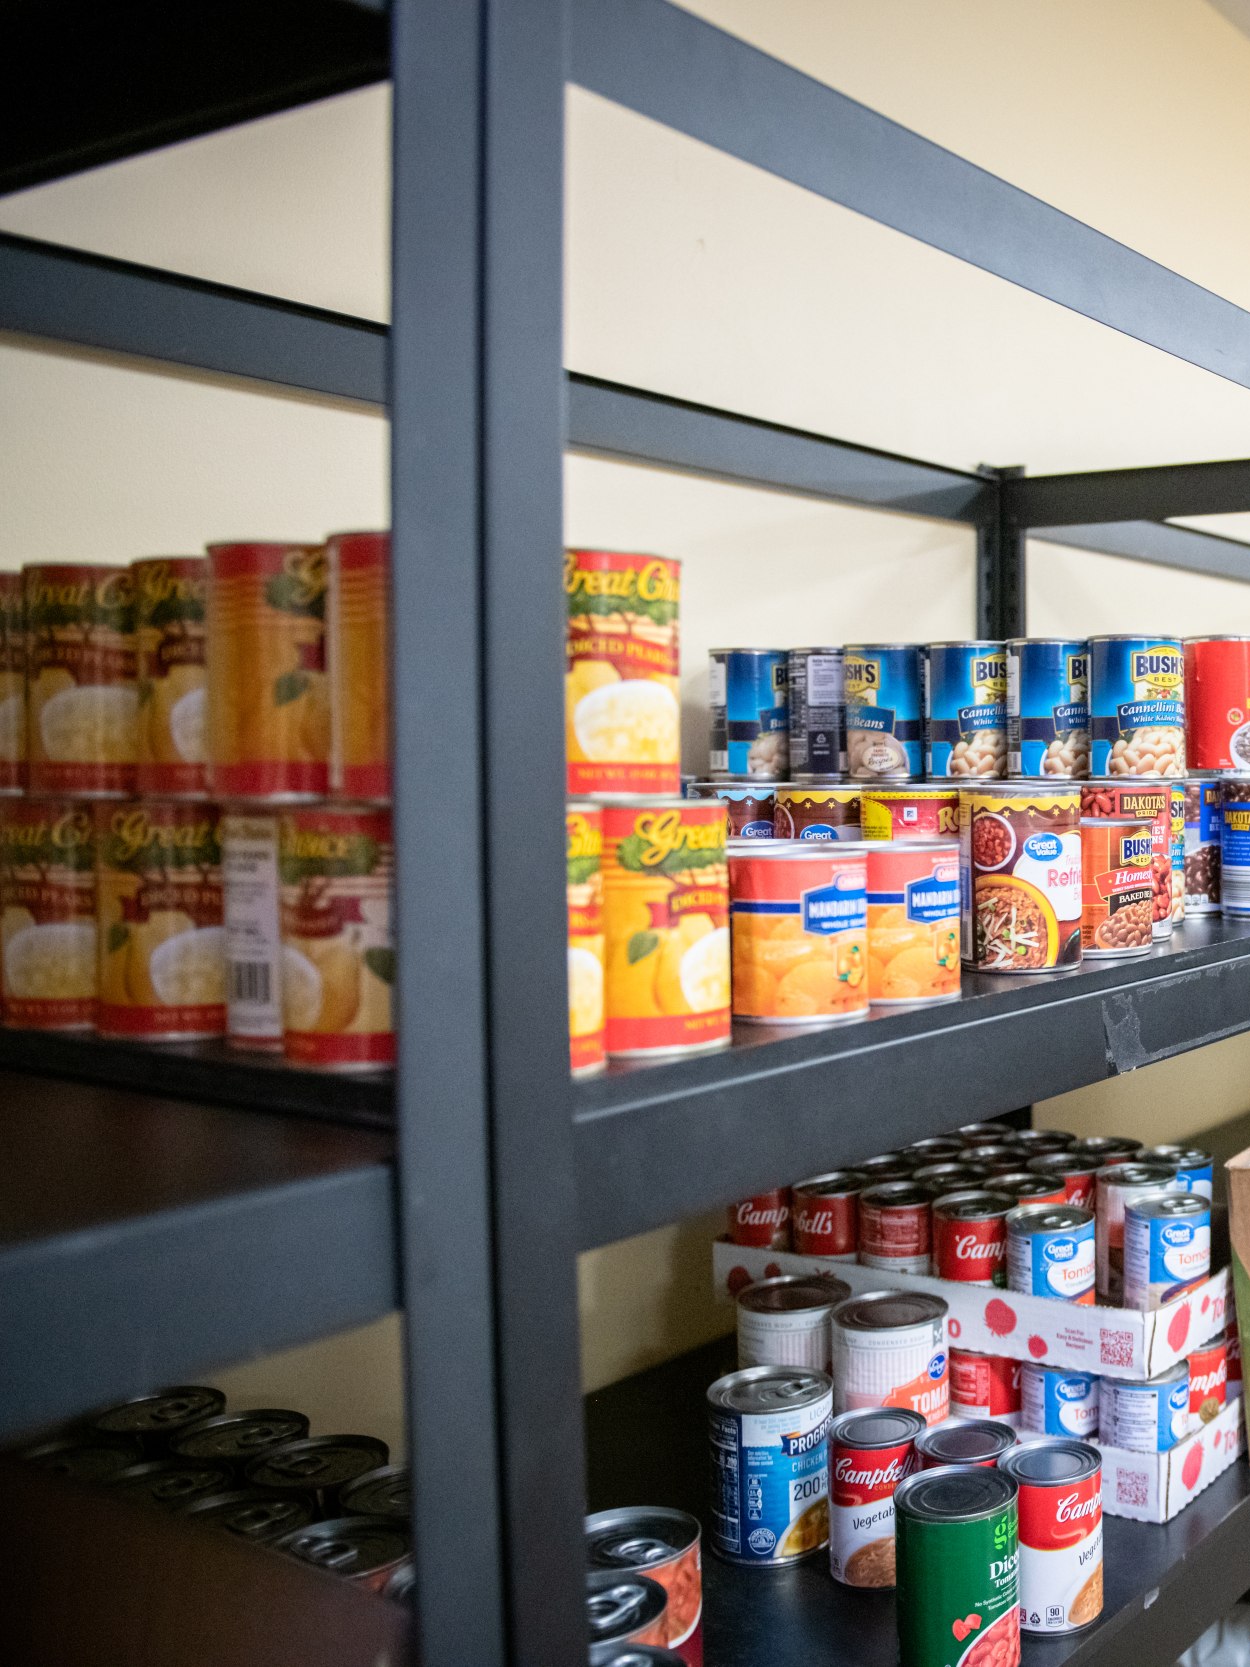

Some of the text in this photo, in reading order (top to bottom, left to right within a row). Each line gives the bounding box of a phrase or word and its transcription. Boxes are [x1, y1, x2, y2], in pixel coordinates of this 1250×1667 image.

[1120, 701, 1175, 716] Cannellini
[853, 717, 885, 730] Beans
[1123, 795, 1166, 810] DAKOTA'S
[1028, 840, 1057, 851] Great
[1035, 848, 1058, 856] Value
[1119, 892, 1143, 904] BAKED
[794, 1476, 820, 1502] 200
[1050, 1608, 1060, 1617] 90
